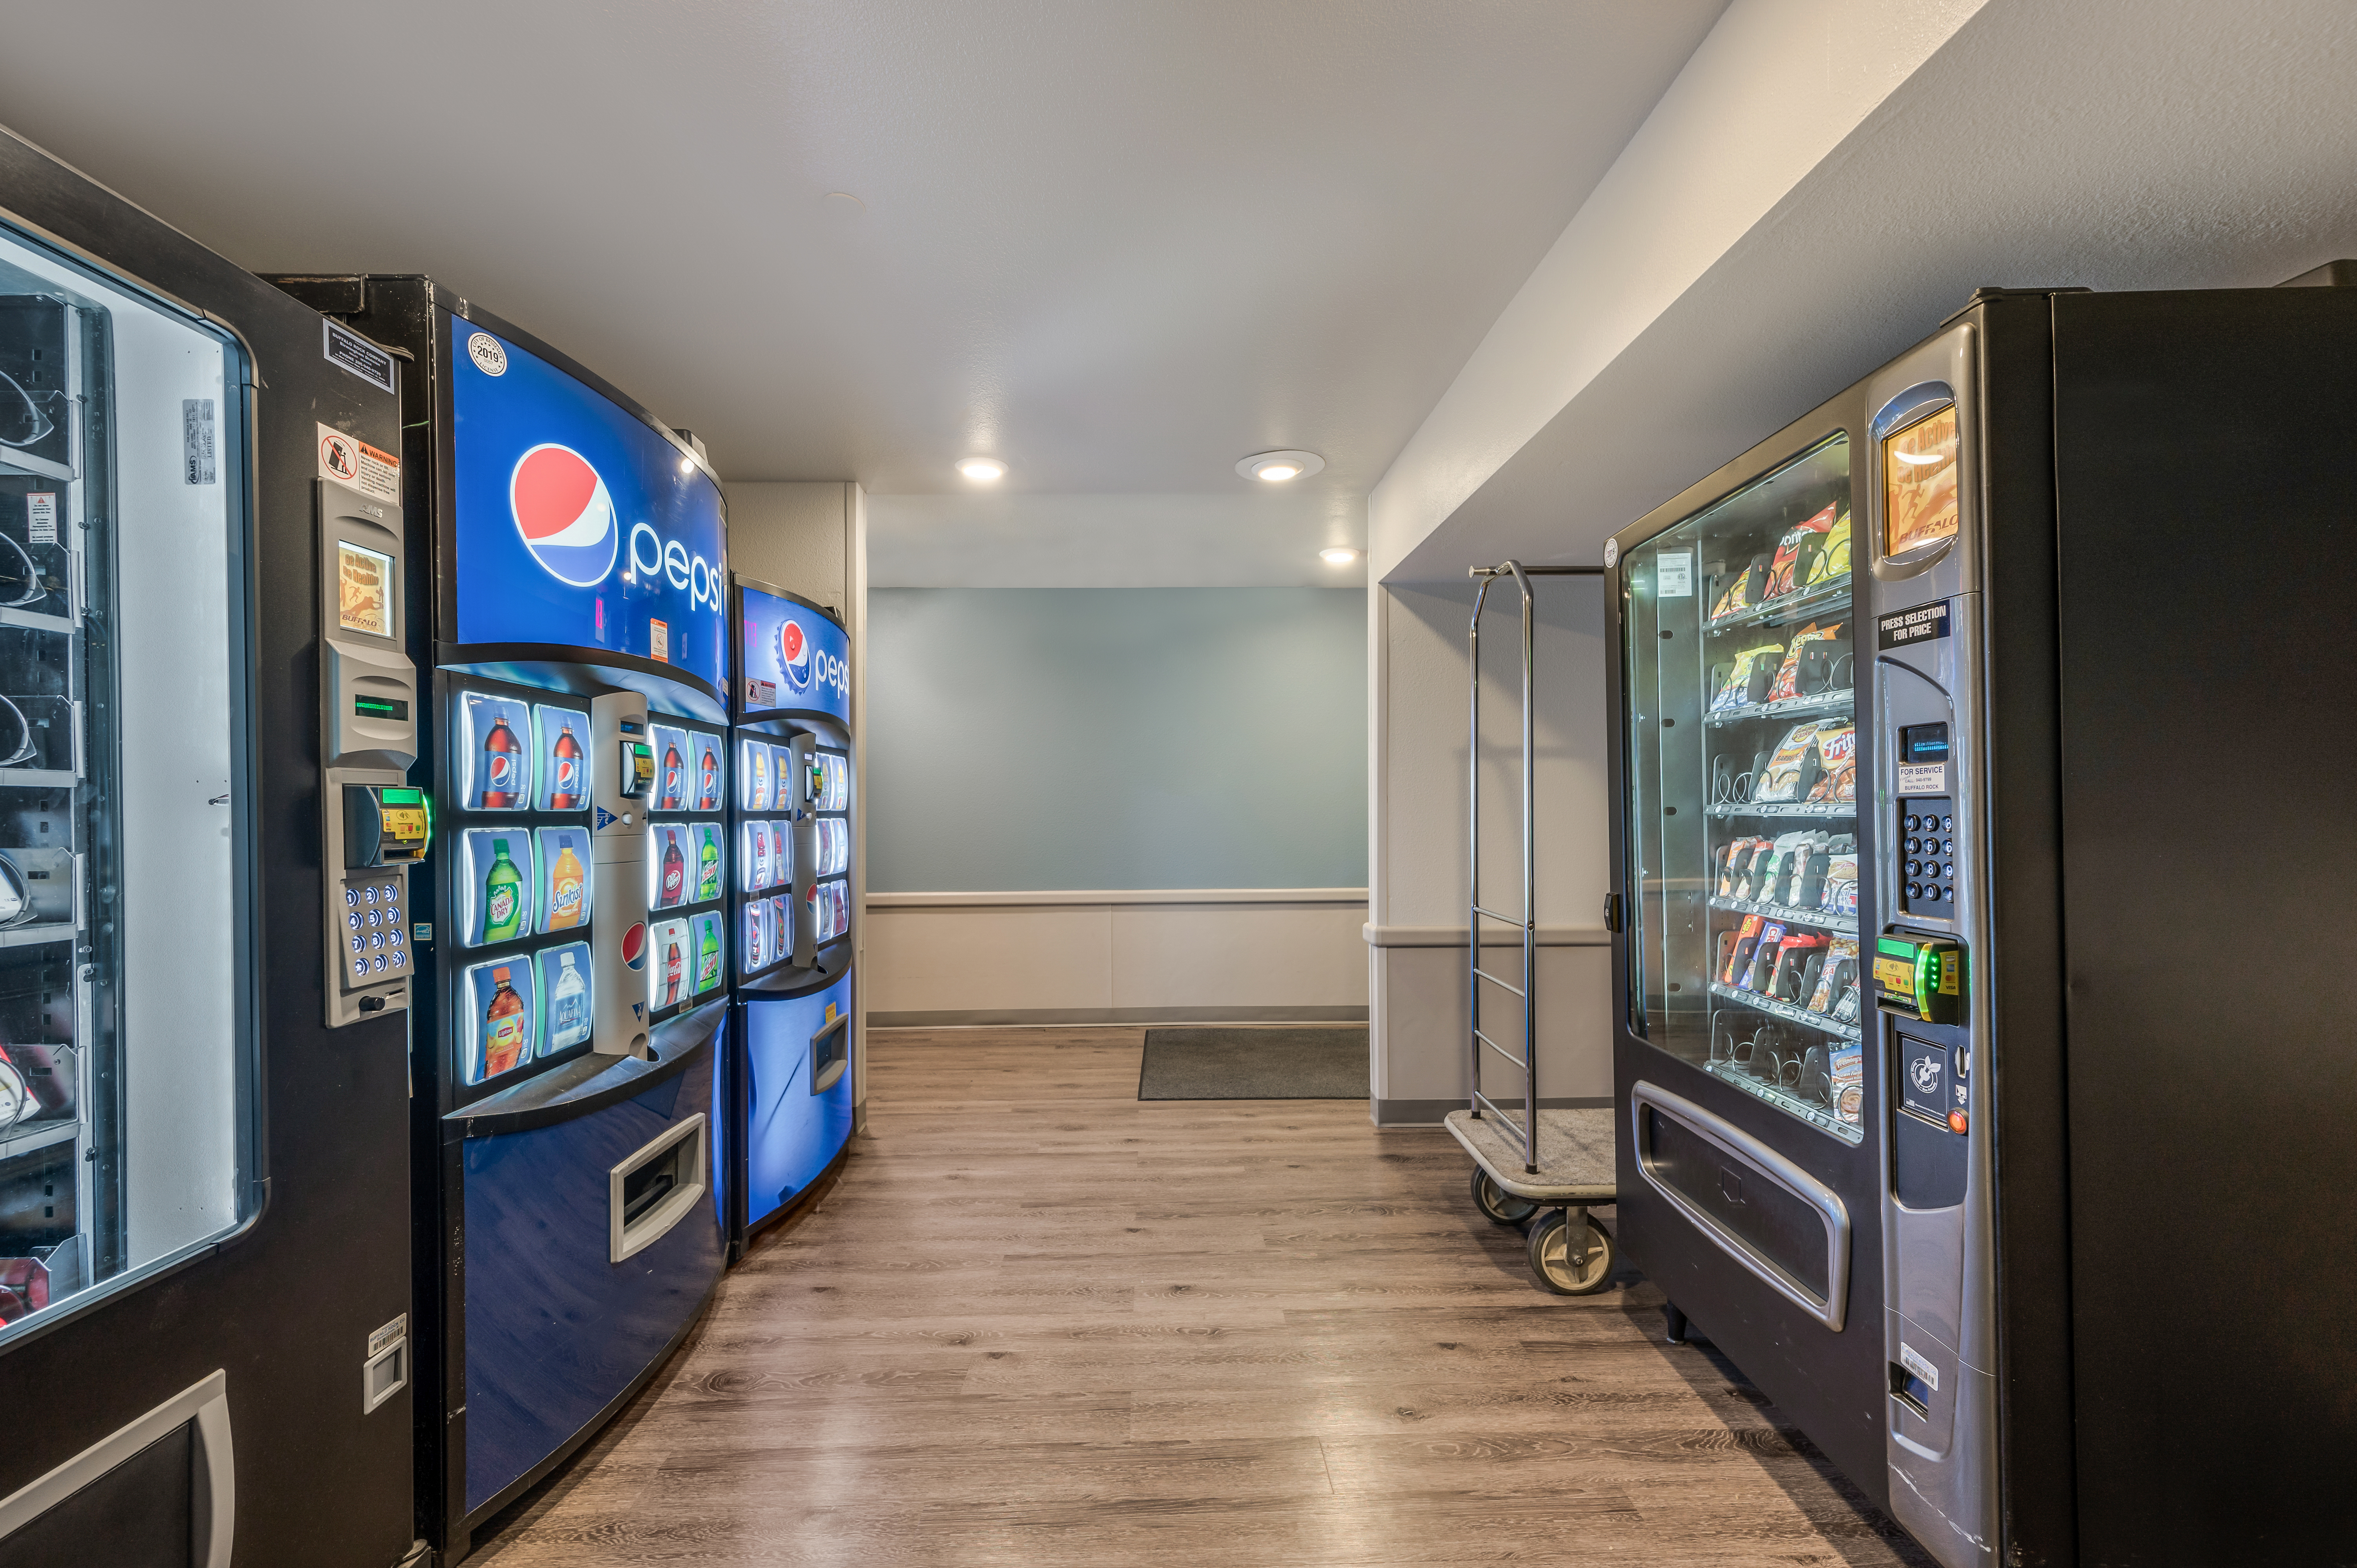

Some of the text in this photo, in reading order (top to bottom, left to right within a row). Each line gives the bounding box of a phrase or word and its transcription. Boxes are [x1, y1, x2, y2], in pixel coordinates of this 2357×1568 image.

[333, 333, 352, 346] BUFFALO
[353, 344, 365, 354] ROCK
[366, 352, 386, 365] COMPANY
[340, 342, 364, 358] Birmingham
[365, 355, 380, 367] Division
[477, 345, 498, 362] 2019
[486, 338, 503, 359] BESSEMER
[339, 351, 354, 362] PHONE
[480, 362, 498, 372] LICENSE
[1917, 419, 1955, 453] Active
[369, 450, 397, 467] WARNING
[361, 461, 375, 469] Machine
[361, 475, 375, 484] Vending
[1897, 466, 1911, 483] Be
[368, 483, 383, 492] dispense
[359, 503, 382, 518] AMS
[1899, 514, 1958, 545] BUFFALO
[345, 554, 376, 572] Be Active
[631, 522, 722, 616] pepsi
[343, 566, 379, 585] Be Healthy
[342, 615, 377, 627] BUFFALO
[1881, 605, 1946, 631] PRESS SELECTION
[1893, 622, 1931, 641] FOR PRICE
[815, 650, 850, 699] pepsi
[1795, 731, 1813, 739] Flake
[1822, 733, 1856, 760] Frit
[1915, 766, 1942, 775] SERVICE
[1909, 818, 1913, 829] 1
[1927, 818, 1933, 828] 2
[1945, 818, 1951, 829] 3
[1909, 840, 1914, 851] 4
[1927, 841, 1933, 852] 5
[1946, 842, 1952, 852] 6
[1910, 863, 1915, 874] 7
[1928, 864, 1933, 875] 8
[1946, 865, 1953, 876] 9
[667, 875, 680, 888] Pepper
[366, 892, 372, 900] 2
[552, 882, 583, 914] Sunkist
[1928, 887, 1933, 897] 0
[347, 894, 352, 903] 1
[490, 896, 513, 916] CANADA
[497, 907, 508, 919] DRY
[558, 1005, 581, 1024] AQUAFINA
[499, 1028, 512, 1036] Lipton
[370, 1329, 388, 1343] BUFFALO
[388, 1321, 399, 1330] ROCK
[1902, 1346, 1918, 1361] BUFFALO
[1919, 1360, 1929, 1369] ROCK
